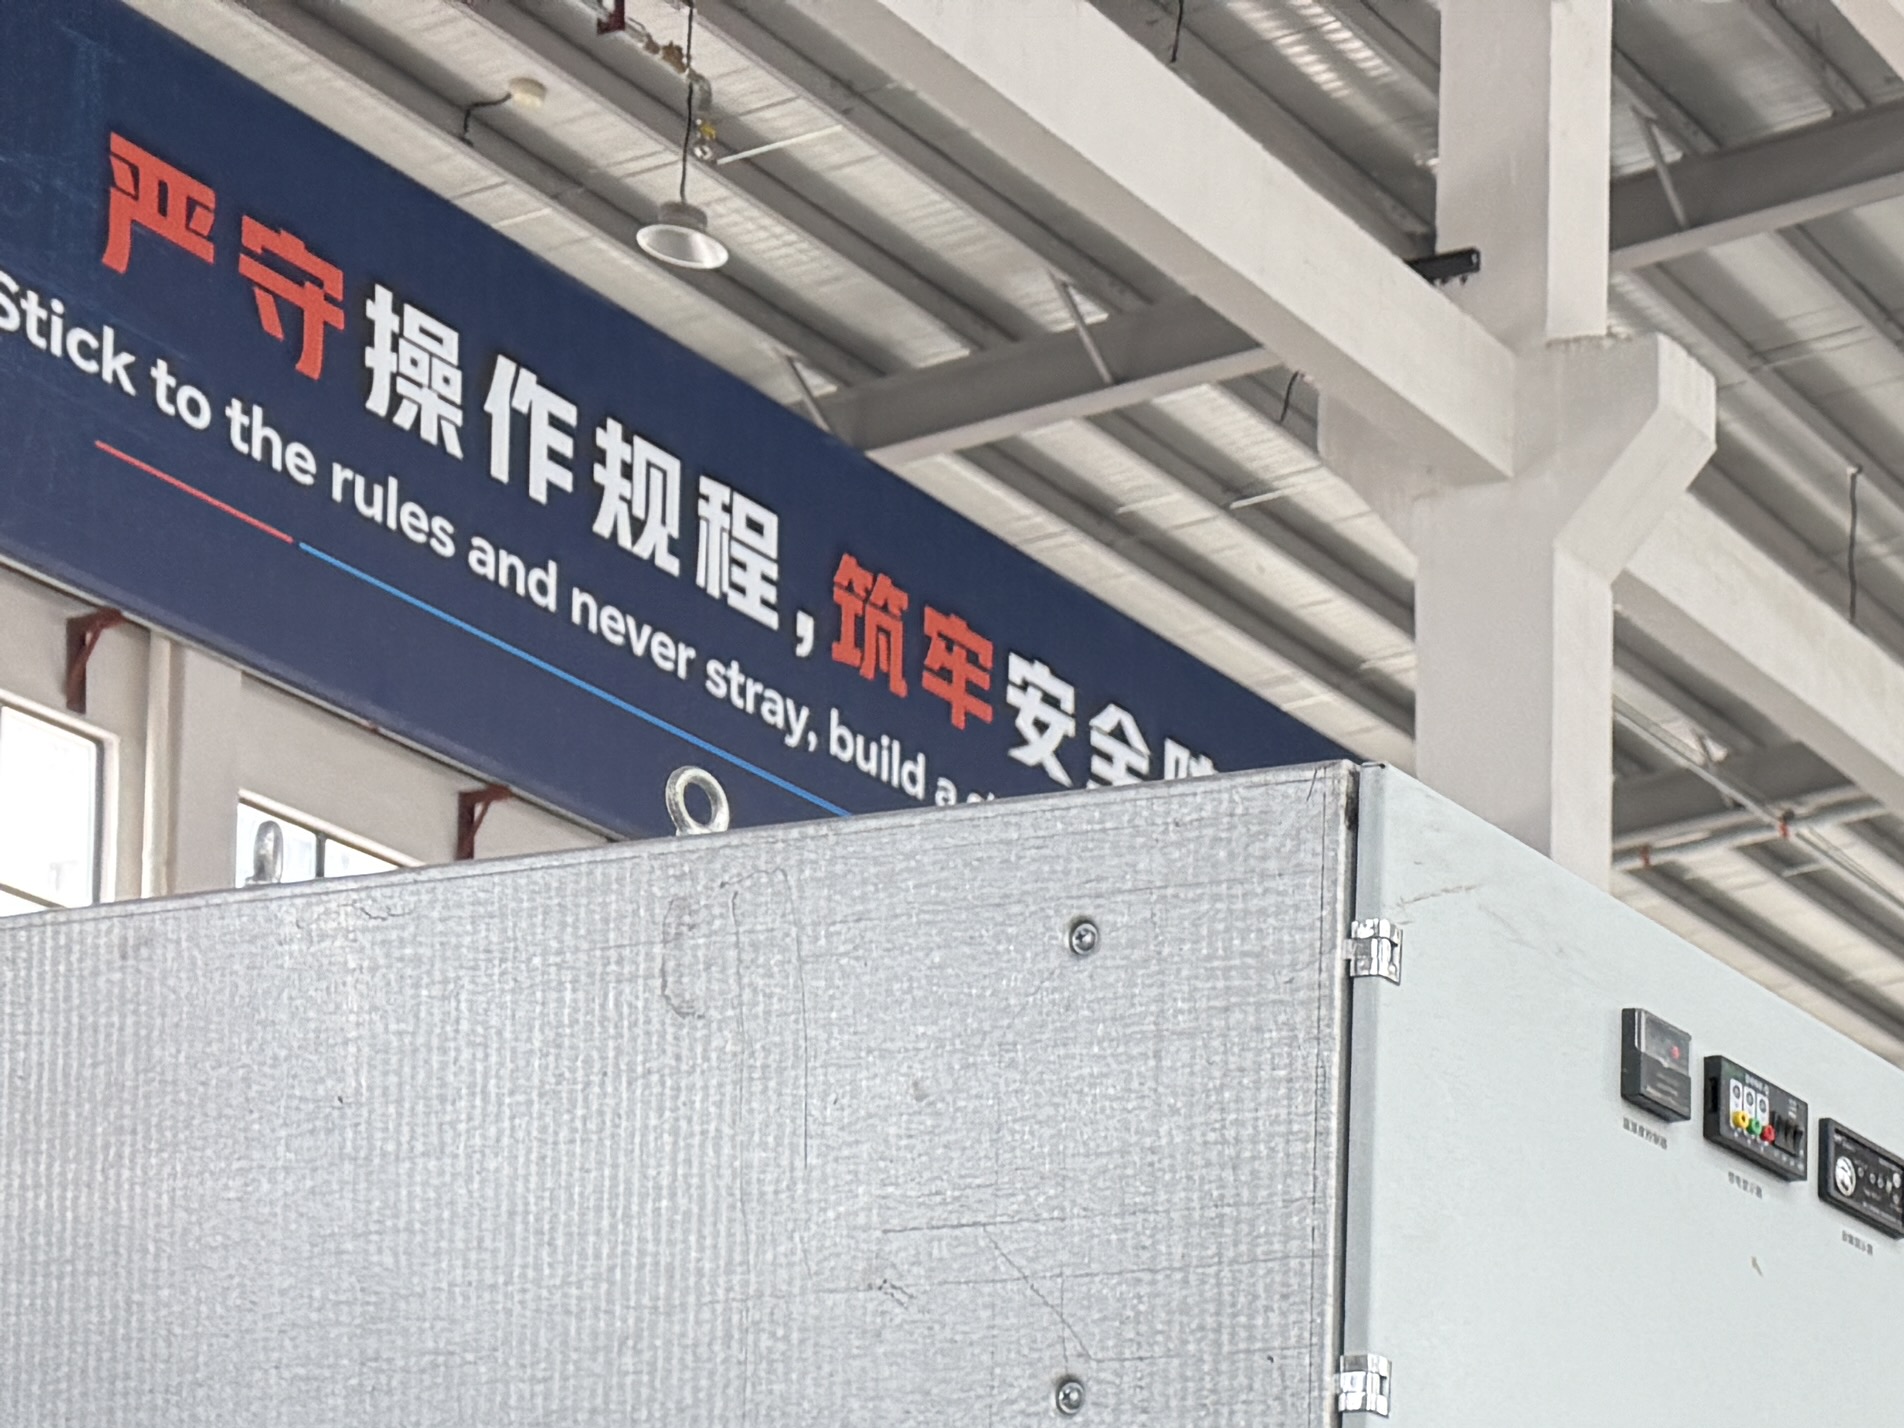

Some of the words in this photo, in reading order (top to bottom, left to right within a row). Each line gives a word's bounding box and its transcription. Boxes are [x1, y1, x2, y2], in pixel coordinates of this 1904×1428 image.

[0, 271, 137, 396] Stick
[151, 358, 212, 430] to
[225, 397, 317, 485] the
[331, 461, 455, 558] rules
[468, 534, 558, 613] and
[571, 584, 696, 681] never
[705, 659, 818, 752] stray,
[829, 706, 927, 800] build
